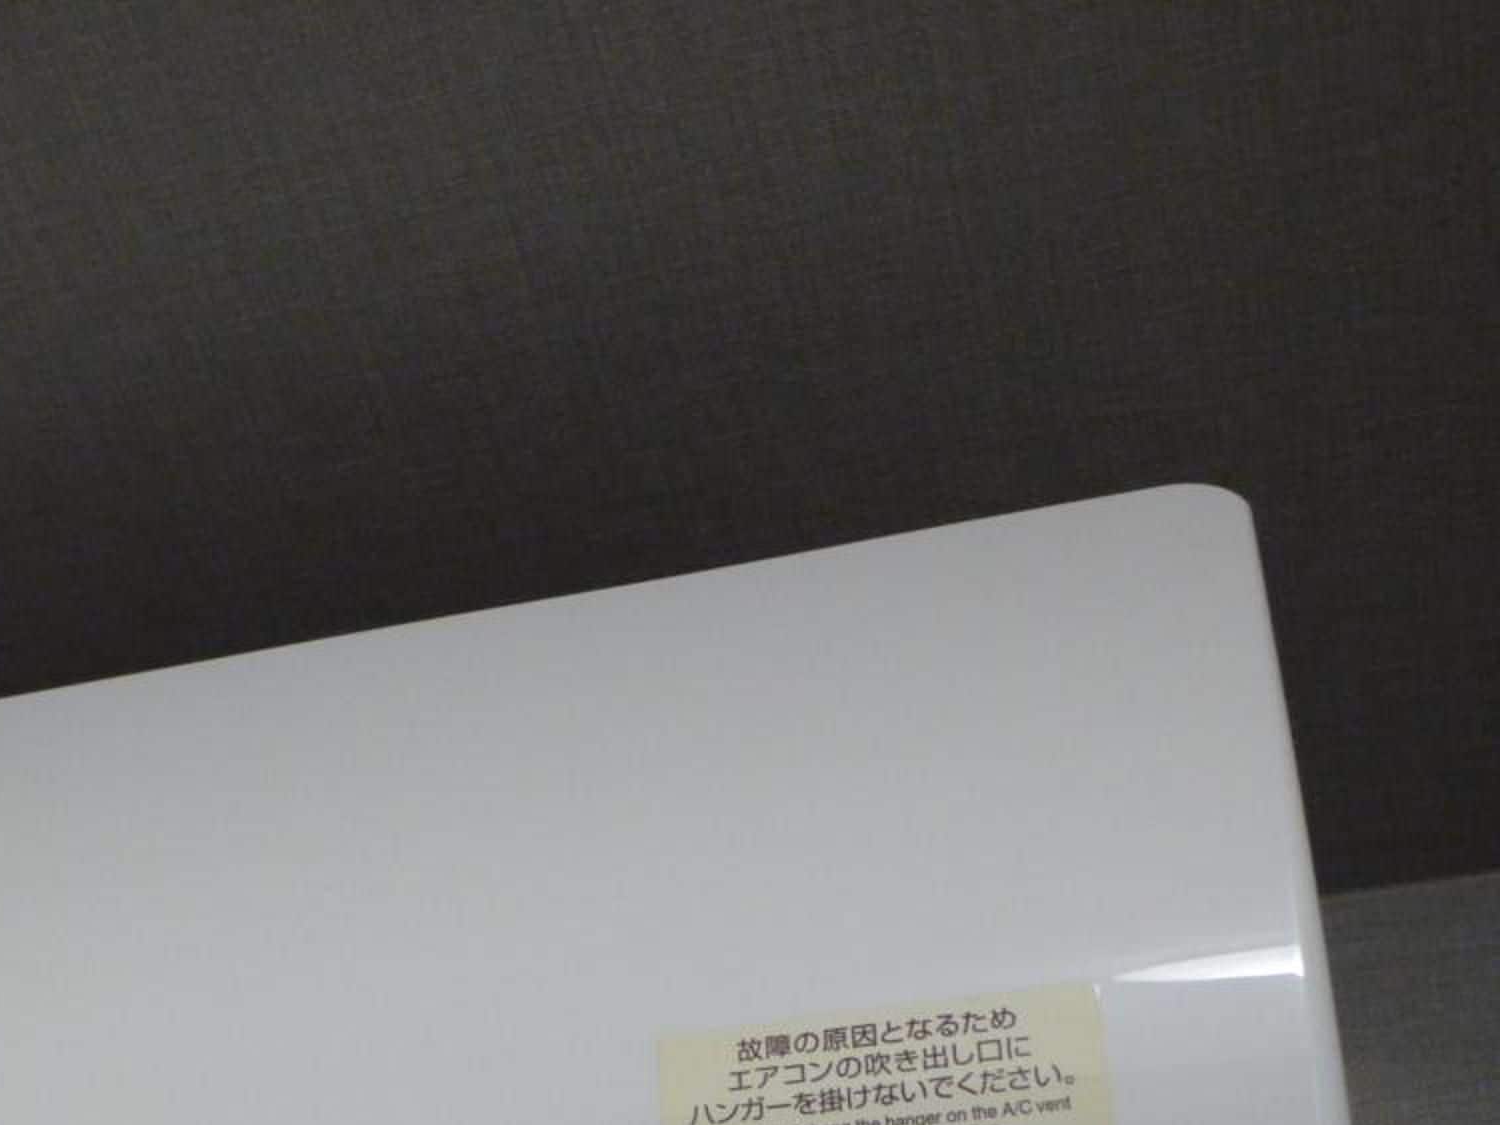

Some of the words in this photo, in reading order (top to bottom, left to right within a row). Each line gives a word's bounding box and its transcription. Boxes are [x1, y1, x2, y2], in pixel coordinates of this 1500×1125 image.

[736, 1007, 1017, 1062] 故障の原因となるため
[729, 1036, 1032, 1092] エアコンの吹き出し口に
[946, 1108, 968, 1122] on
[971, 1104, 998, 1119] the
[1002, 1099, 1032, 1116] A/C
[1035, 1096, 1071, 1112] vent
